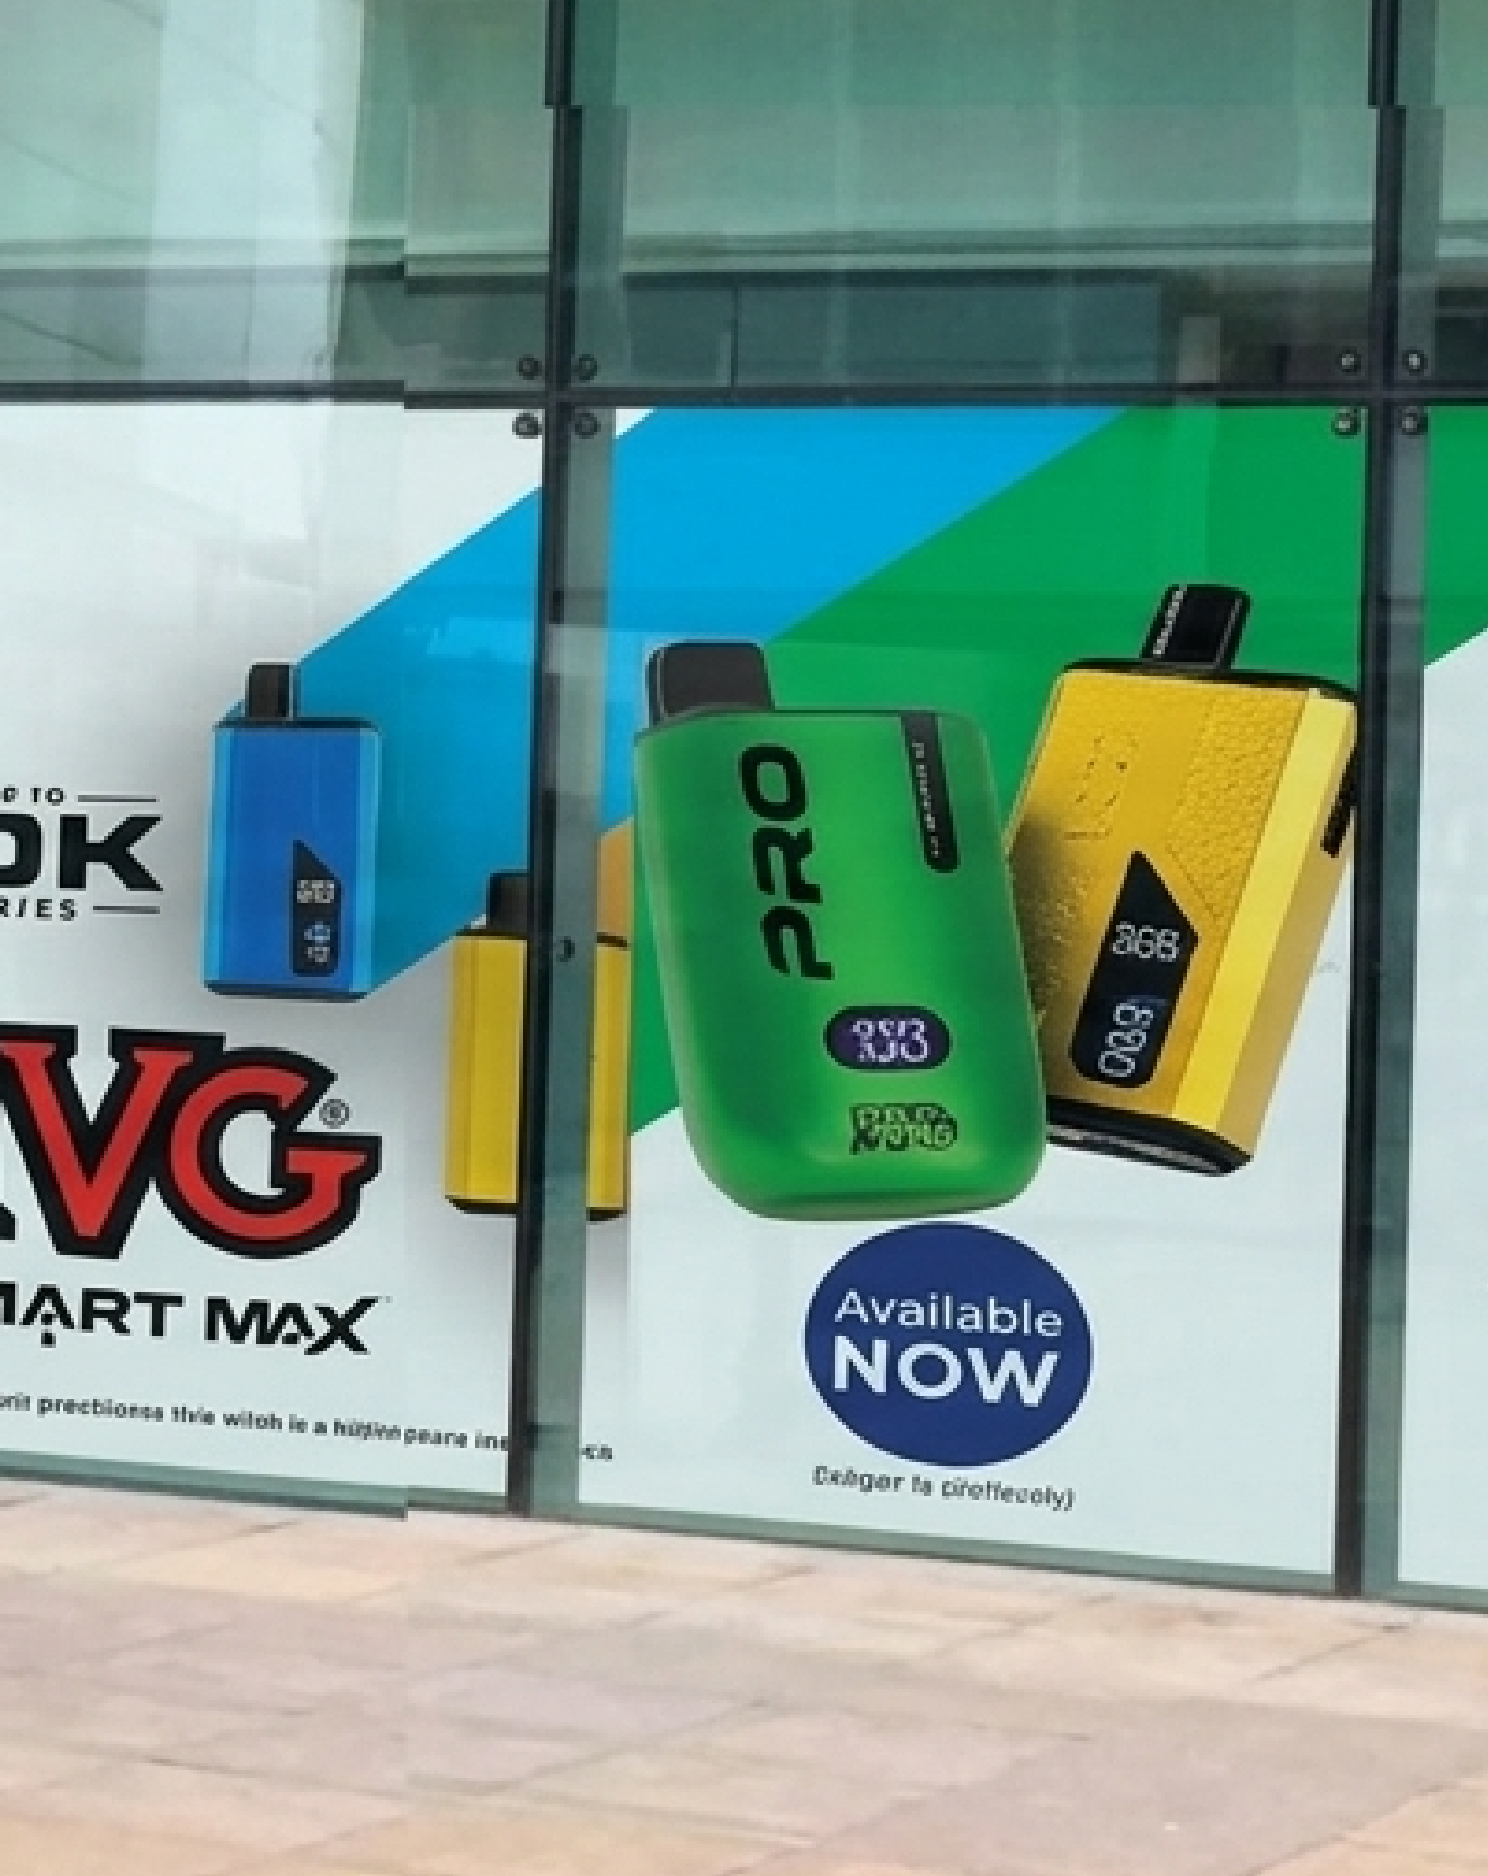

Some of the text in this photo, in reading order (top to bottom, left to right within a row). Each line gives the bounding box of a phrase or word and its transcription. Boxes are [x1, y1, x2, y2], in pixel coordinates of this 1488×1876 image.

[737, 742, 834, 981] PRO
[203, 1295, 379, 1355] MAX
[834, 1288, 1064, 1337] Available
[834, 1335, 1061, 1408] NOW
